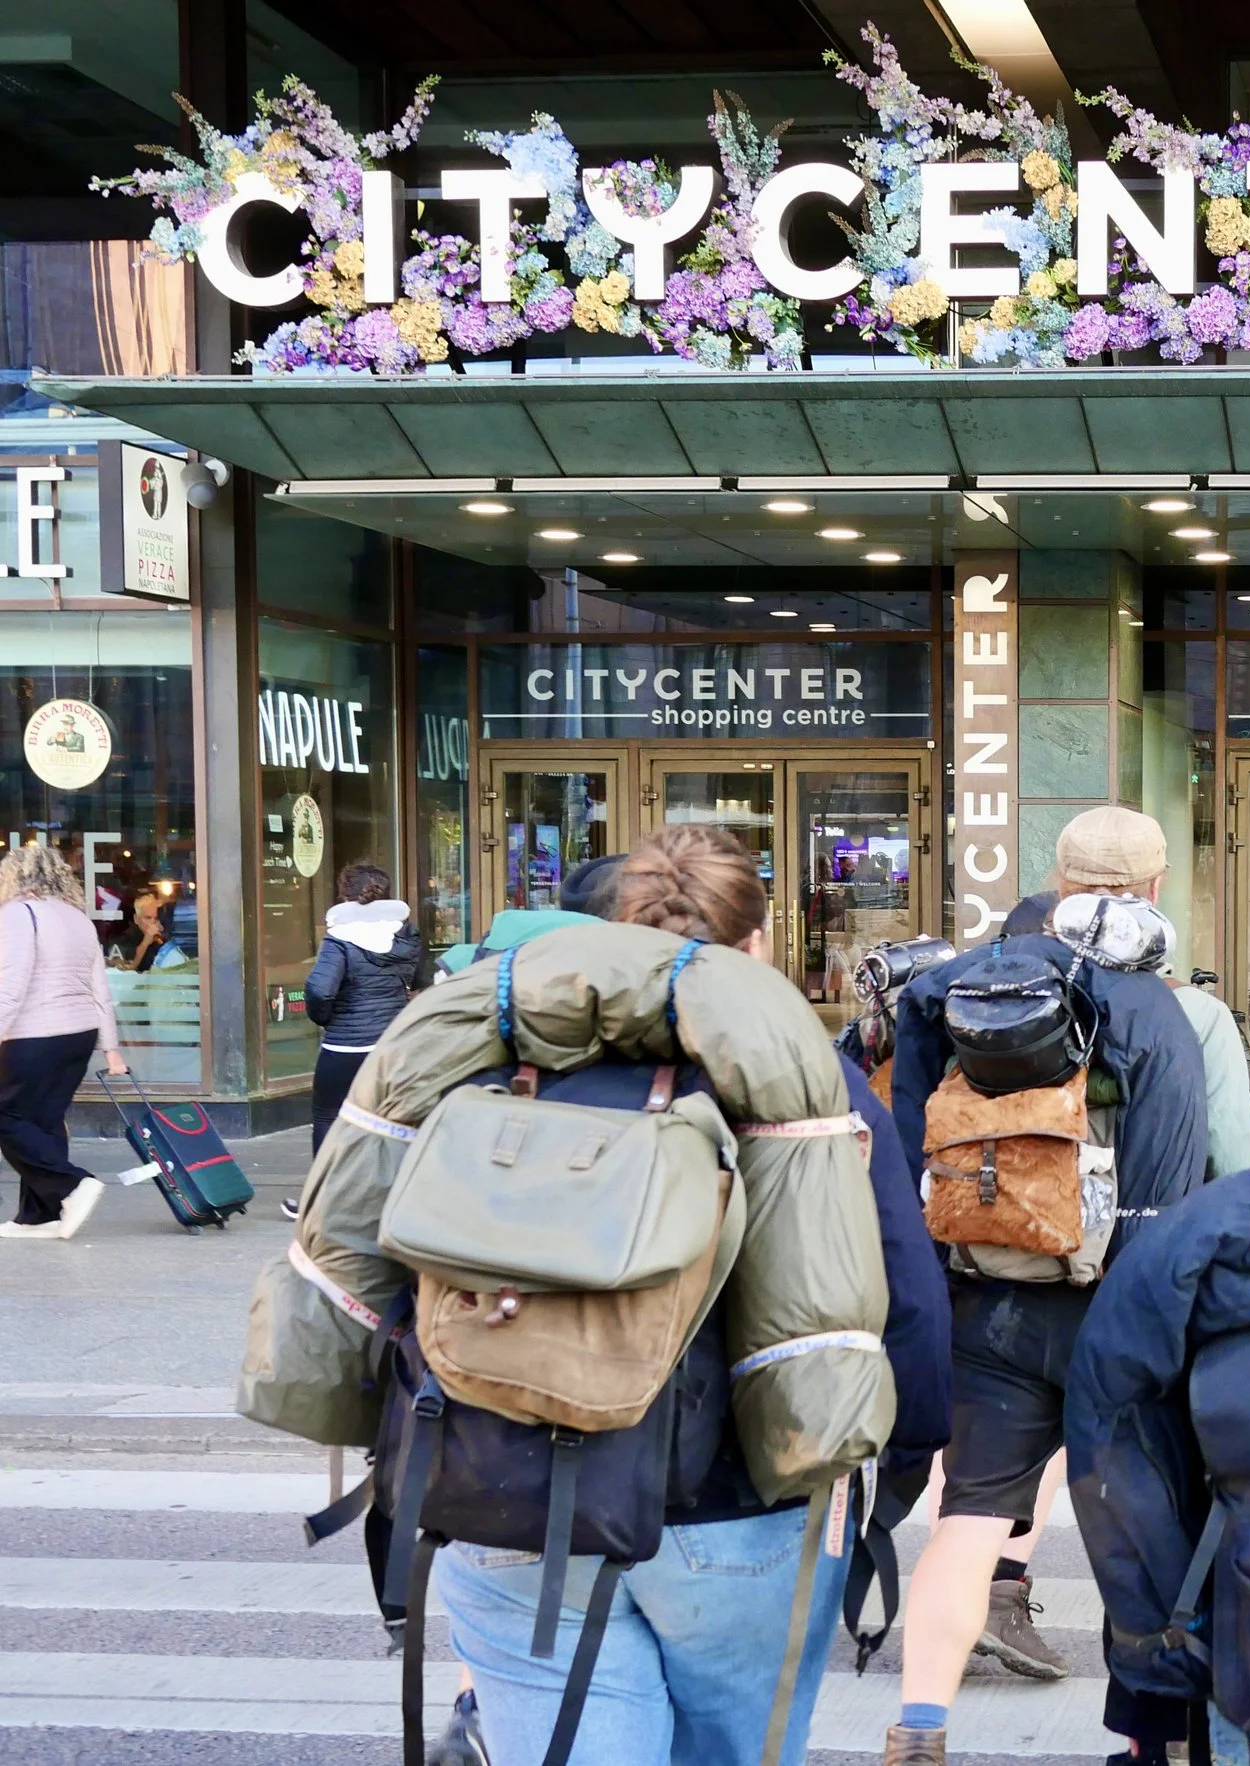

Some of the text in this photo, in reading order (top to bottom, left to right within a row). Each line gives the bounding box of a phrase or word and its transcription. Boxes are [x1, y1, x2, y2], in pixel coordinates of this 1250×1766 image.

[137, 540, 174, 562] VERACE
[138, 559, 175, 581] PIZZA
[138, 579, 175, 593] NAPOLETANA
[527, 668, 864, 701] CITYCENTER
[28, 703, 107, 749] BIRRA MORETTI
[651, 704, 867, 729] shopping centre
[259, 690, 369, 774] NAPULE
[963, 572, 1009, 955] YCENTER
[824, 826, 845, 836] Telia
